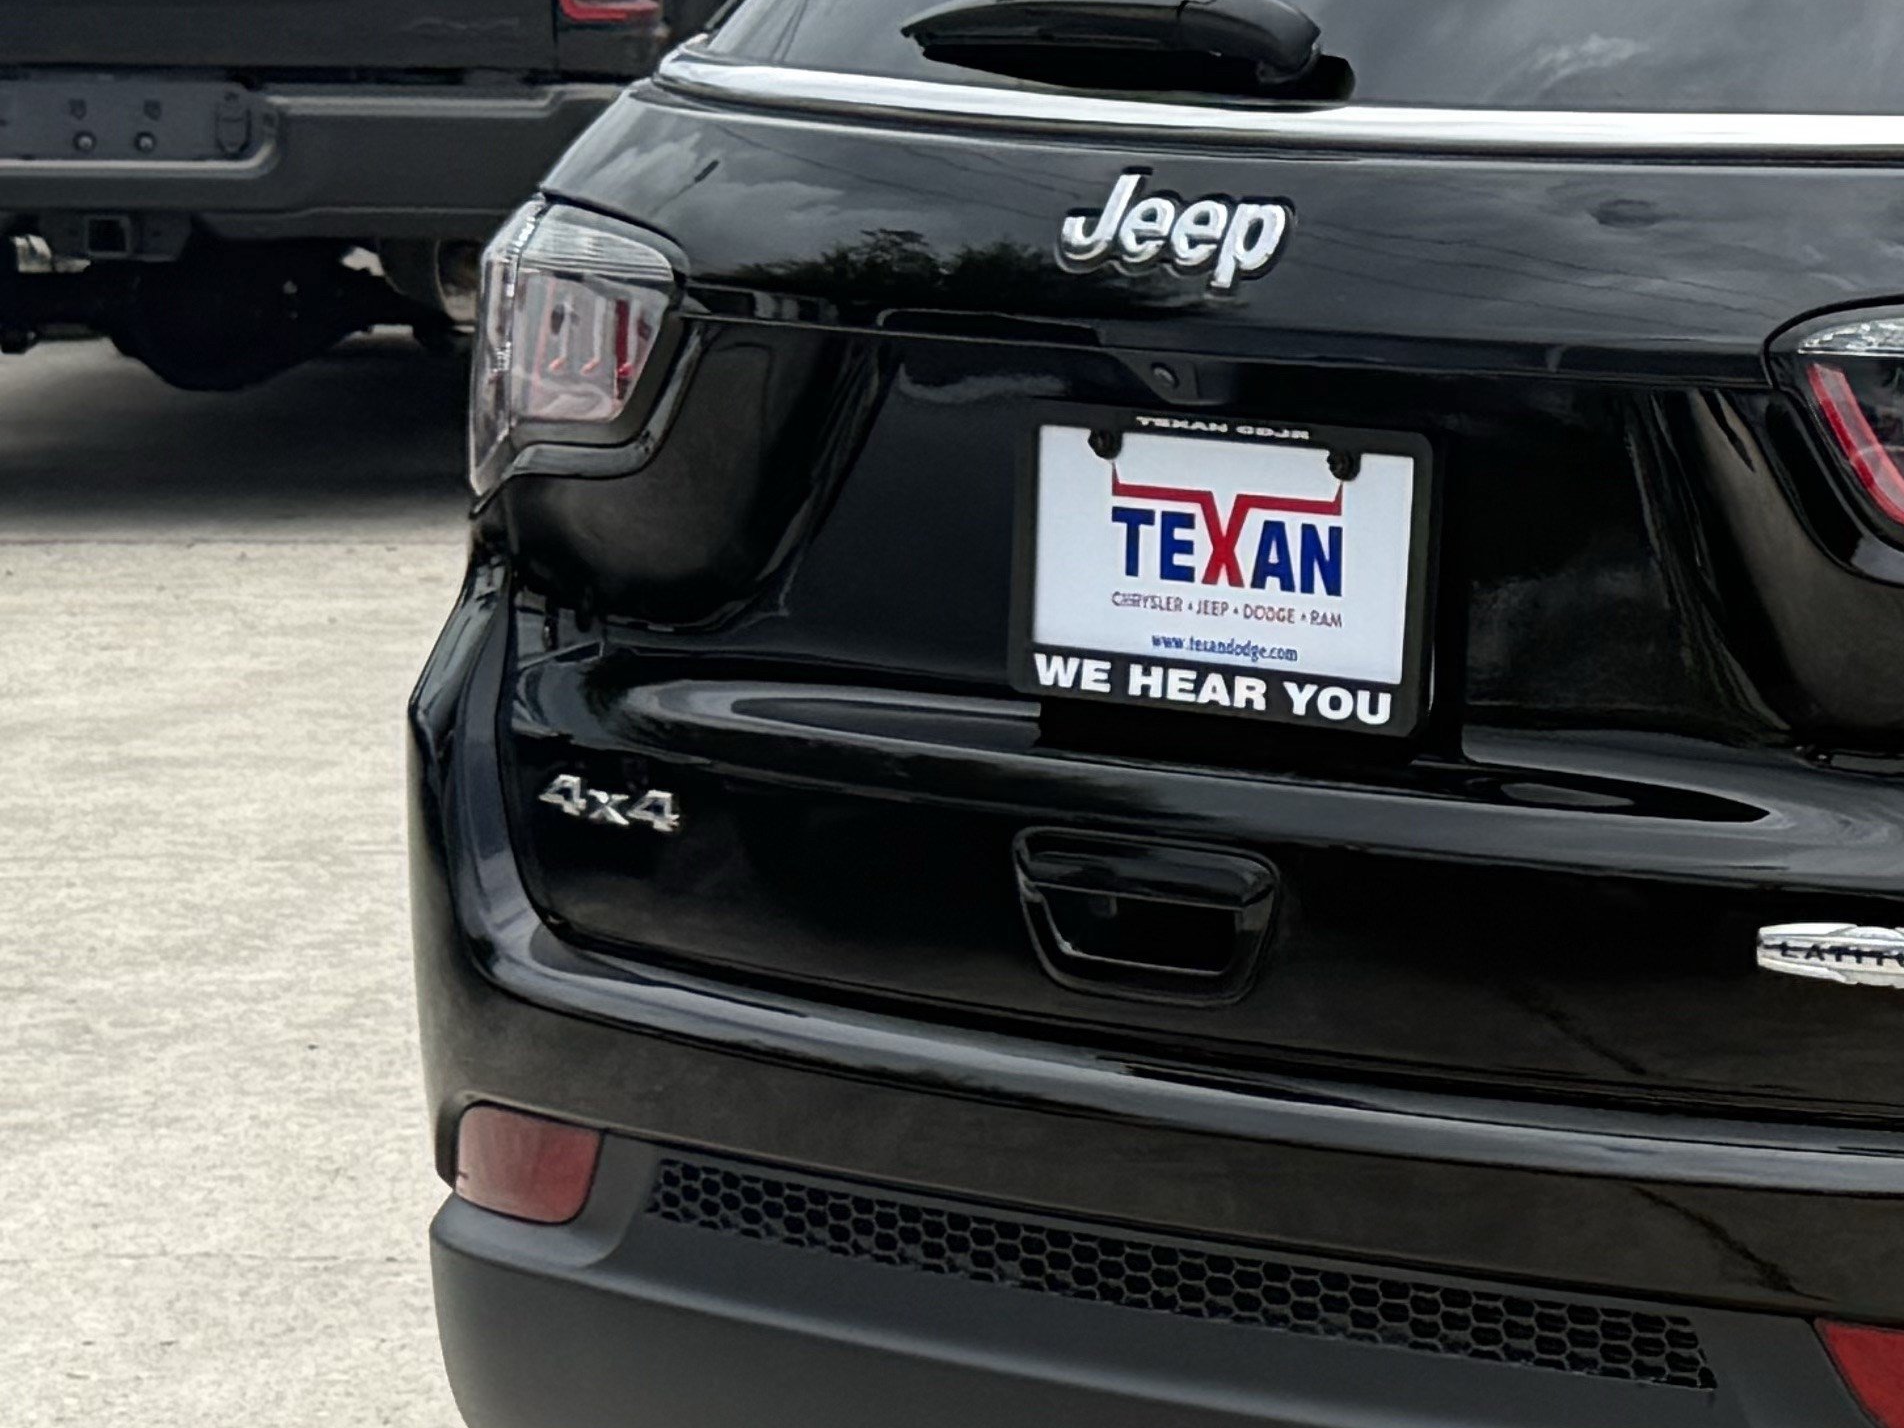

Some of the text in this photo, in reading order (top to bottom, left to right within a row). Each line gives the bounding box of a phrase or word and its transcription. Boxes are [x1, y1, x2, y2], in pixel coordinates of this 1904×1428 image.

[1060, 171, 1289, 290] Jeep
[1135, 415, 1229, 433] TEXAN
[1111, 482, 1344, 597] TEXAN
[1111, 591, 1343, 629] CHRYSLER JEEP DODGE RAM
[1033, 653, 1392, 726] WE HEAR YOU
